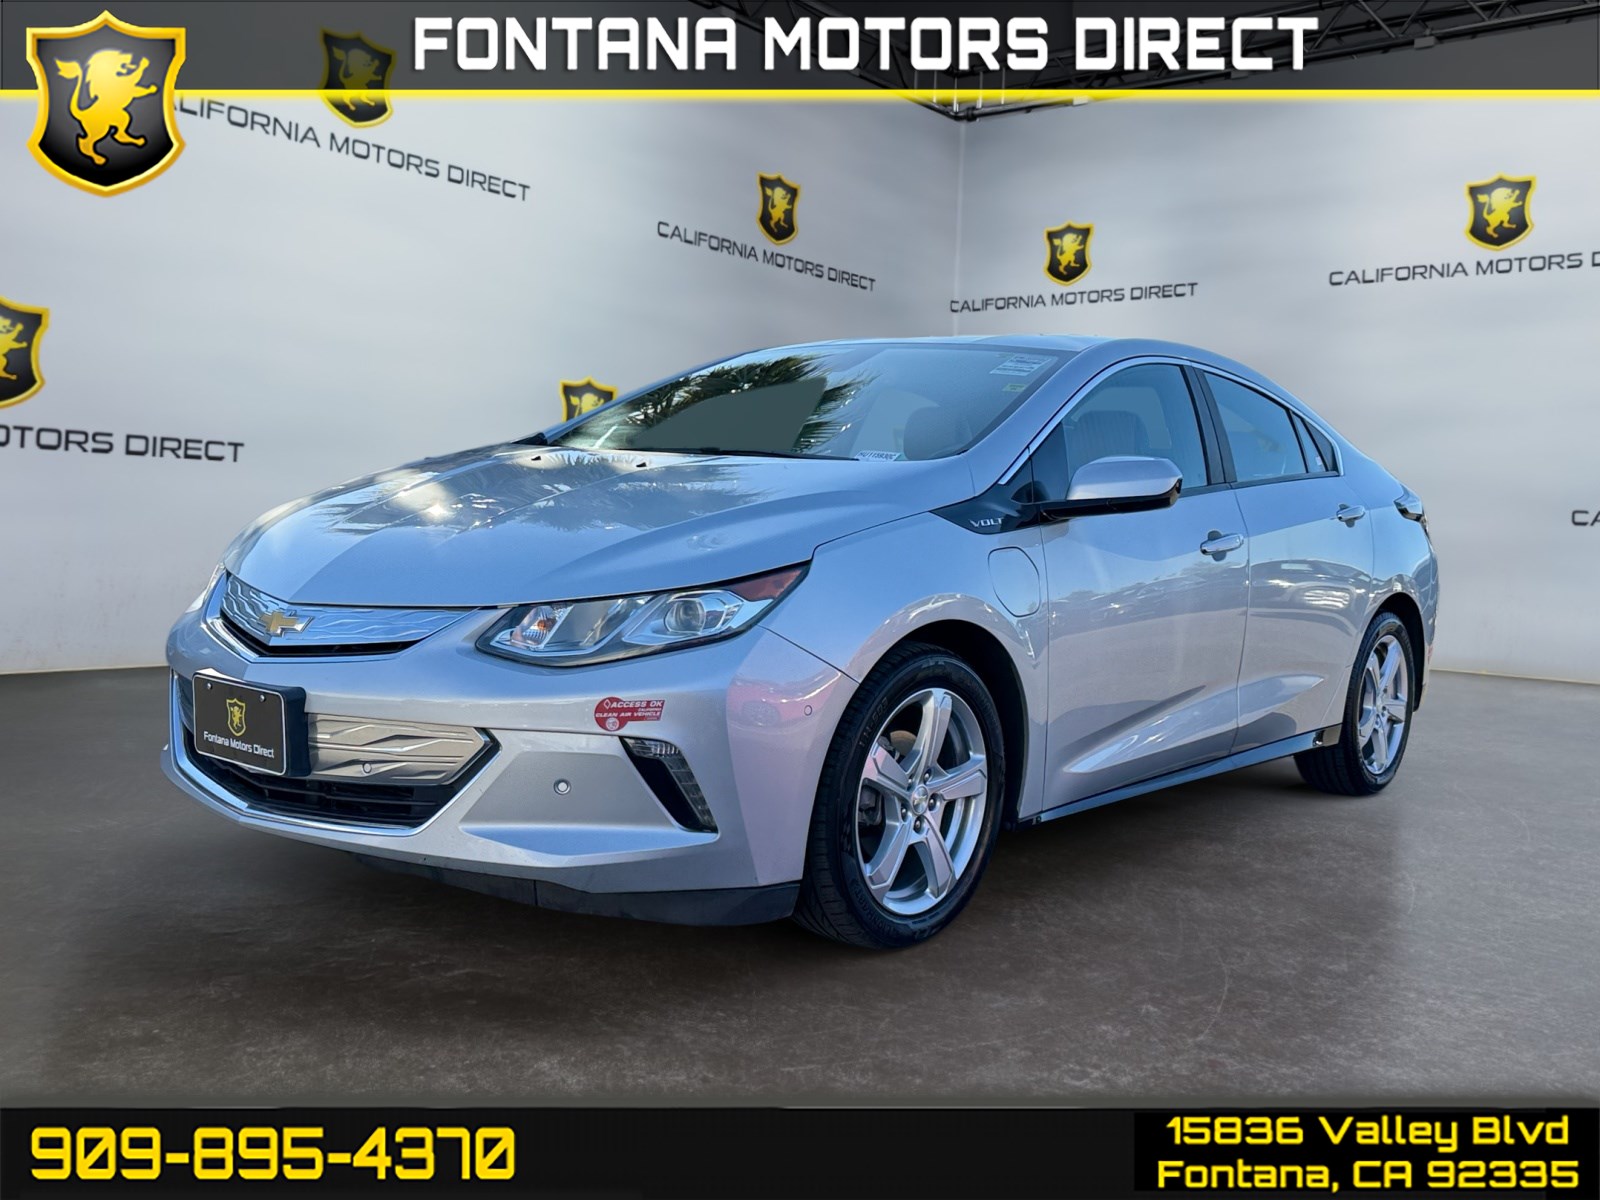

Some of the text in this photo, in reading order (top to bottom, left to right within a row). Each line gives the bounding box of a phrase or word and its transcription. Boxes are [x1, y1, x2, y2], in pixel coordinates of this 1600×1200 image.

[174, 97, 530, 201] LIFORNIA MOTORS DIRECT
[657, 221, 876, 291] CALIFORNIA MOTORS DIRECT
[1329, 262, 1468, 286] CALIFORNIA
[1475, 253, 1583, 275] MOTORS
[950, 282, 1198, 313] CALIFORNIA MOTORS DIRECT
[125, 434, 245, 462] DIRECT
[969, 517, 1004, 528] VOLT
[203, 731, 275, 758] Fontana Motors Direct
